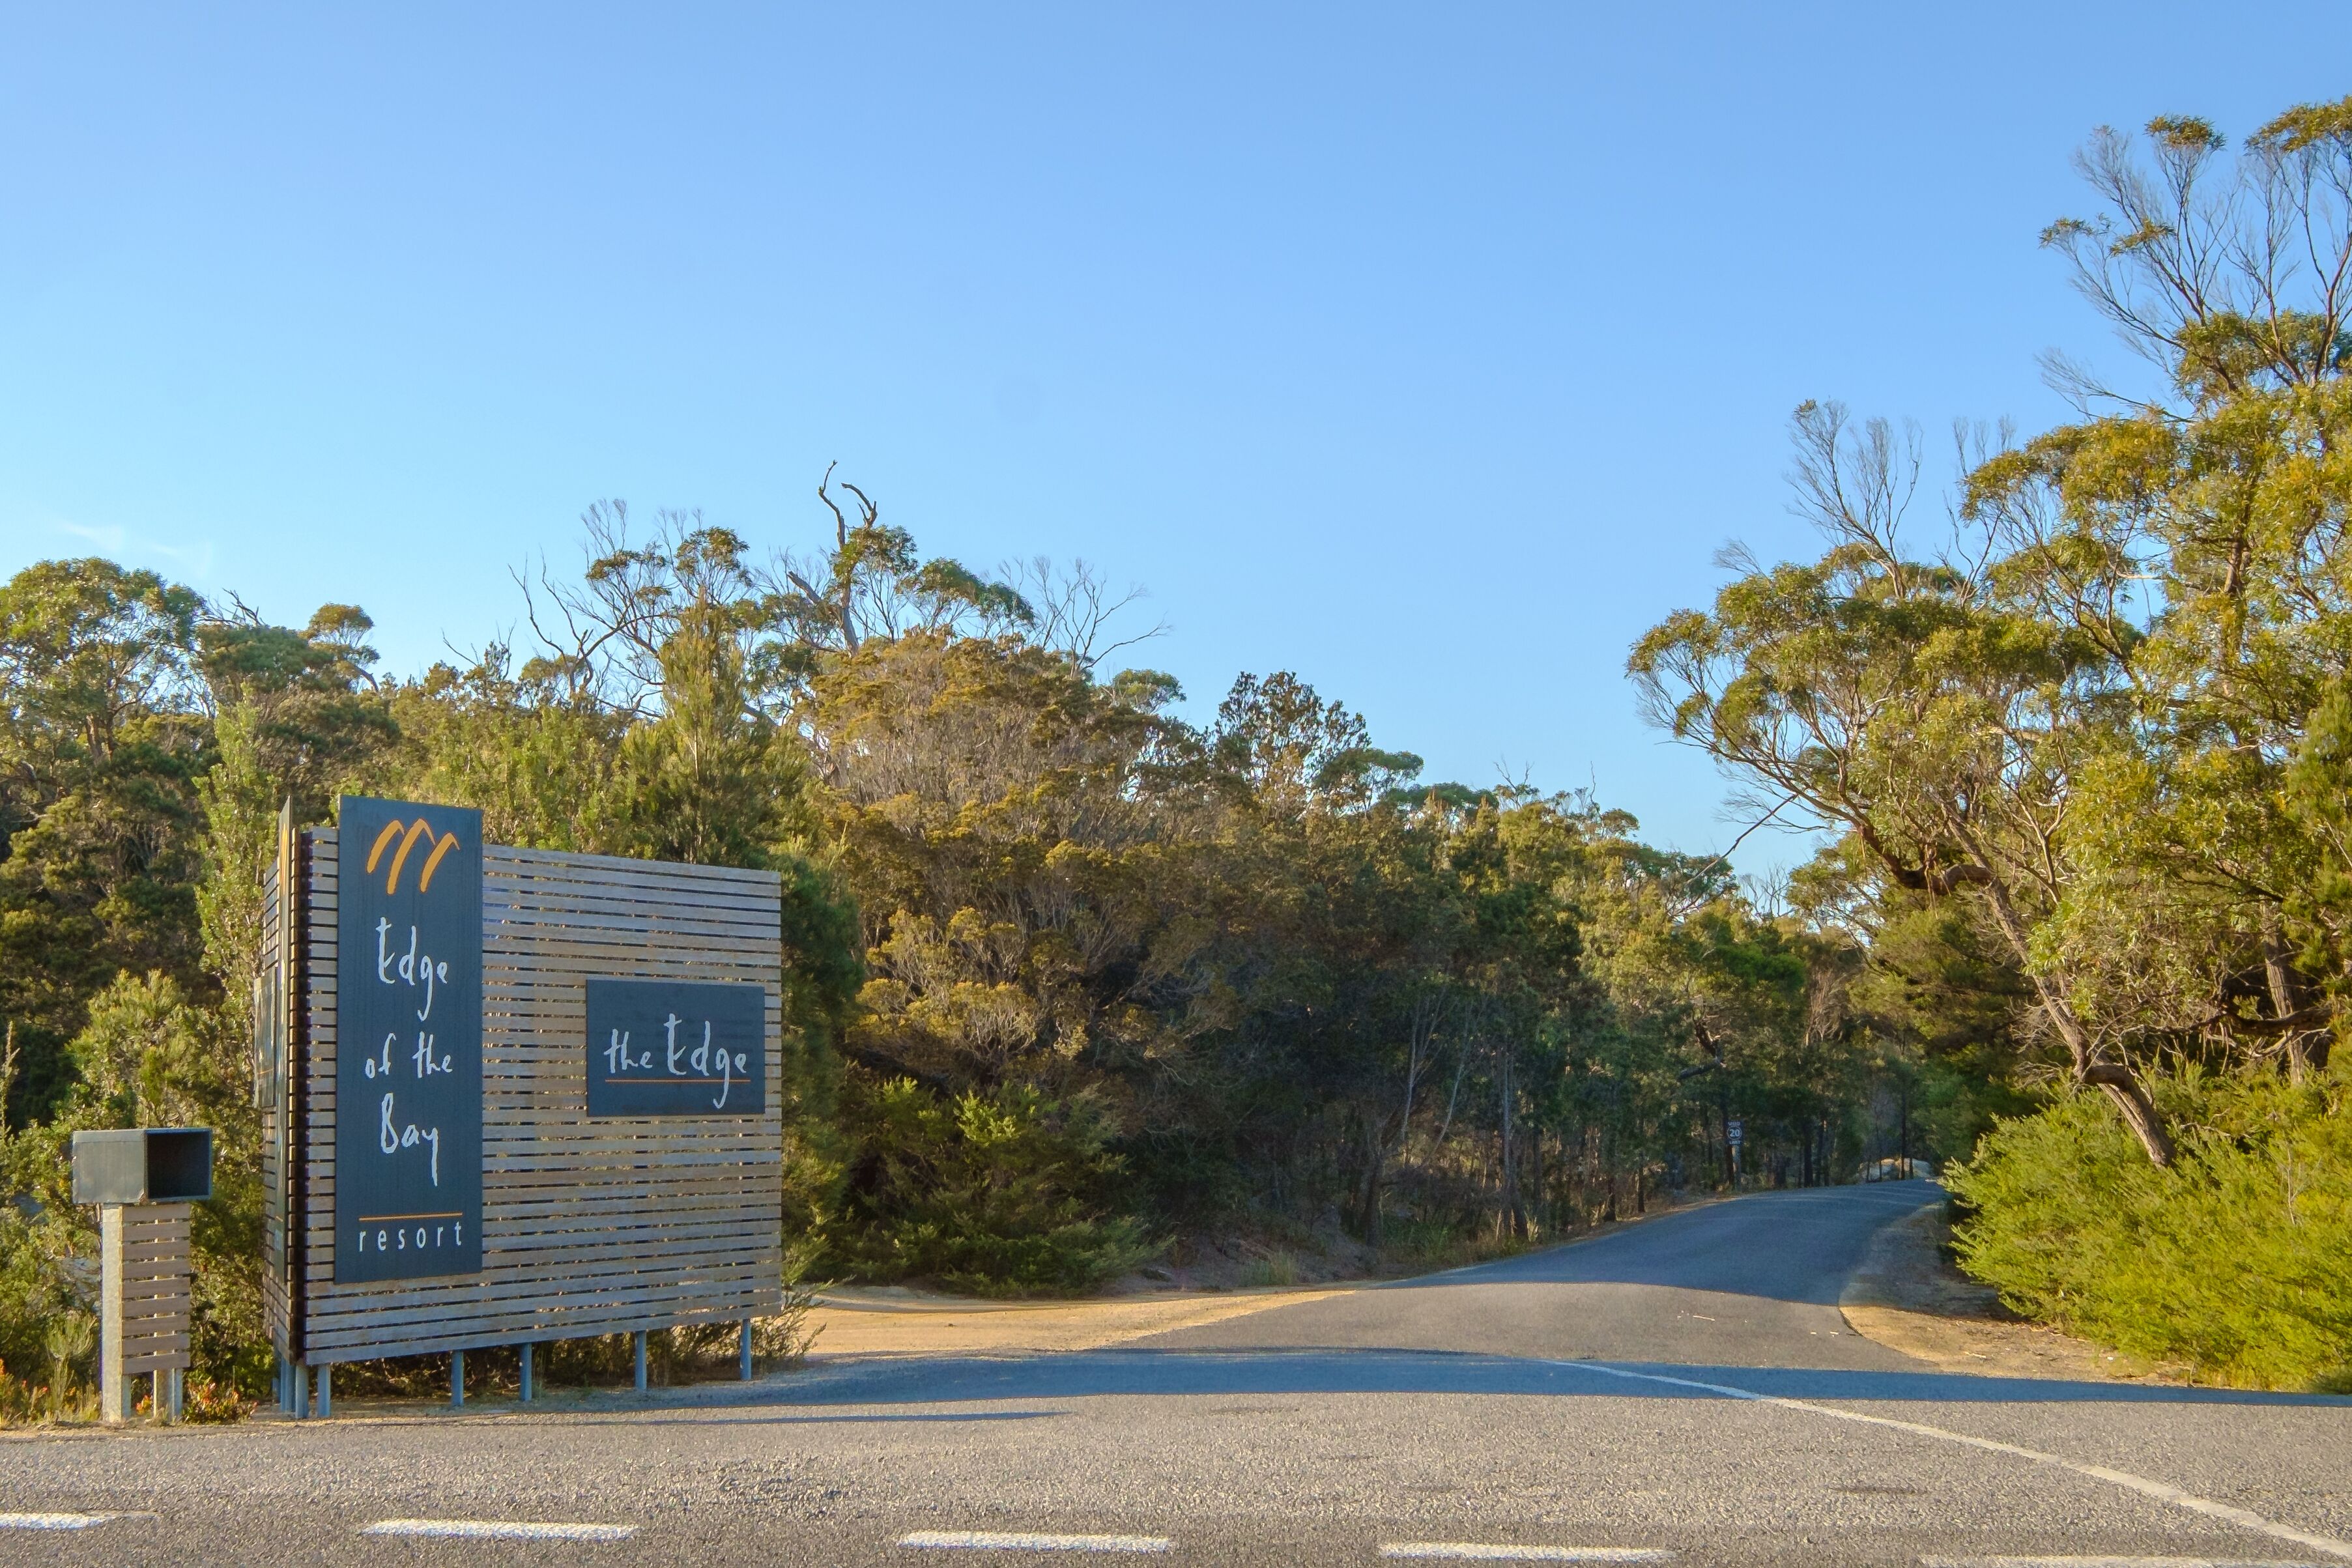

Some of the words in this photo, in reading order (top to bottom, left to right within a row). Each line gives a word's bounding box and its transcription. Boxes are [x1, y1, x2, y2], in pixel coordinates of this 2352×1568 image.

[375, 916, 448, 1021] Edge
[365, 1033, 397, 1079] of
[412, 1031, 453, 1079] the
[603, 1029, 653, 1074] the
[663, 1013, 747, 1109] Edge
[380, 1092, 439, 1186] Bay
[1729, 1128, 1740, 1137] 20
[359, 1221, 462, 1252] resort
